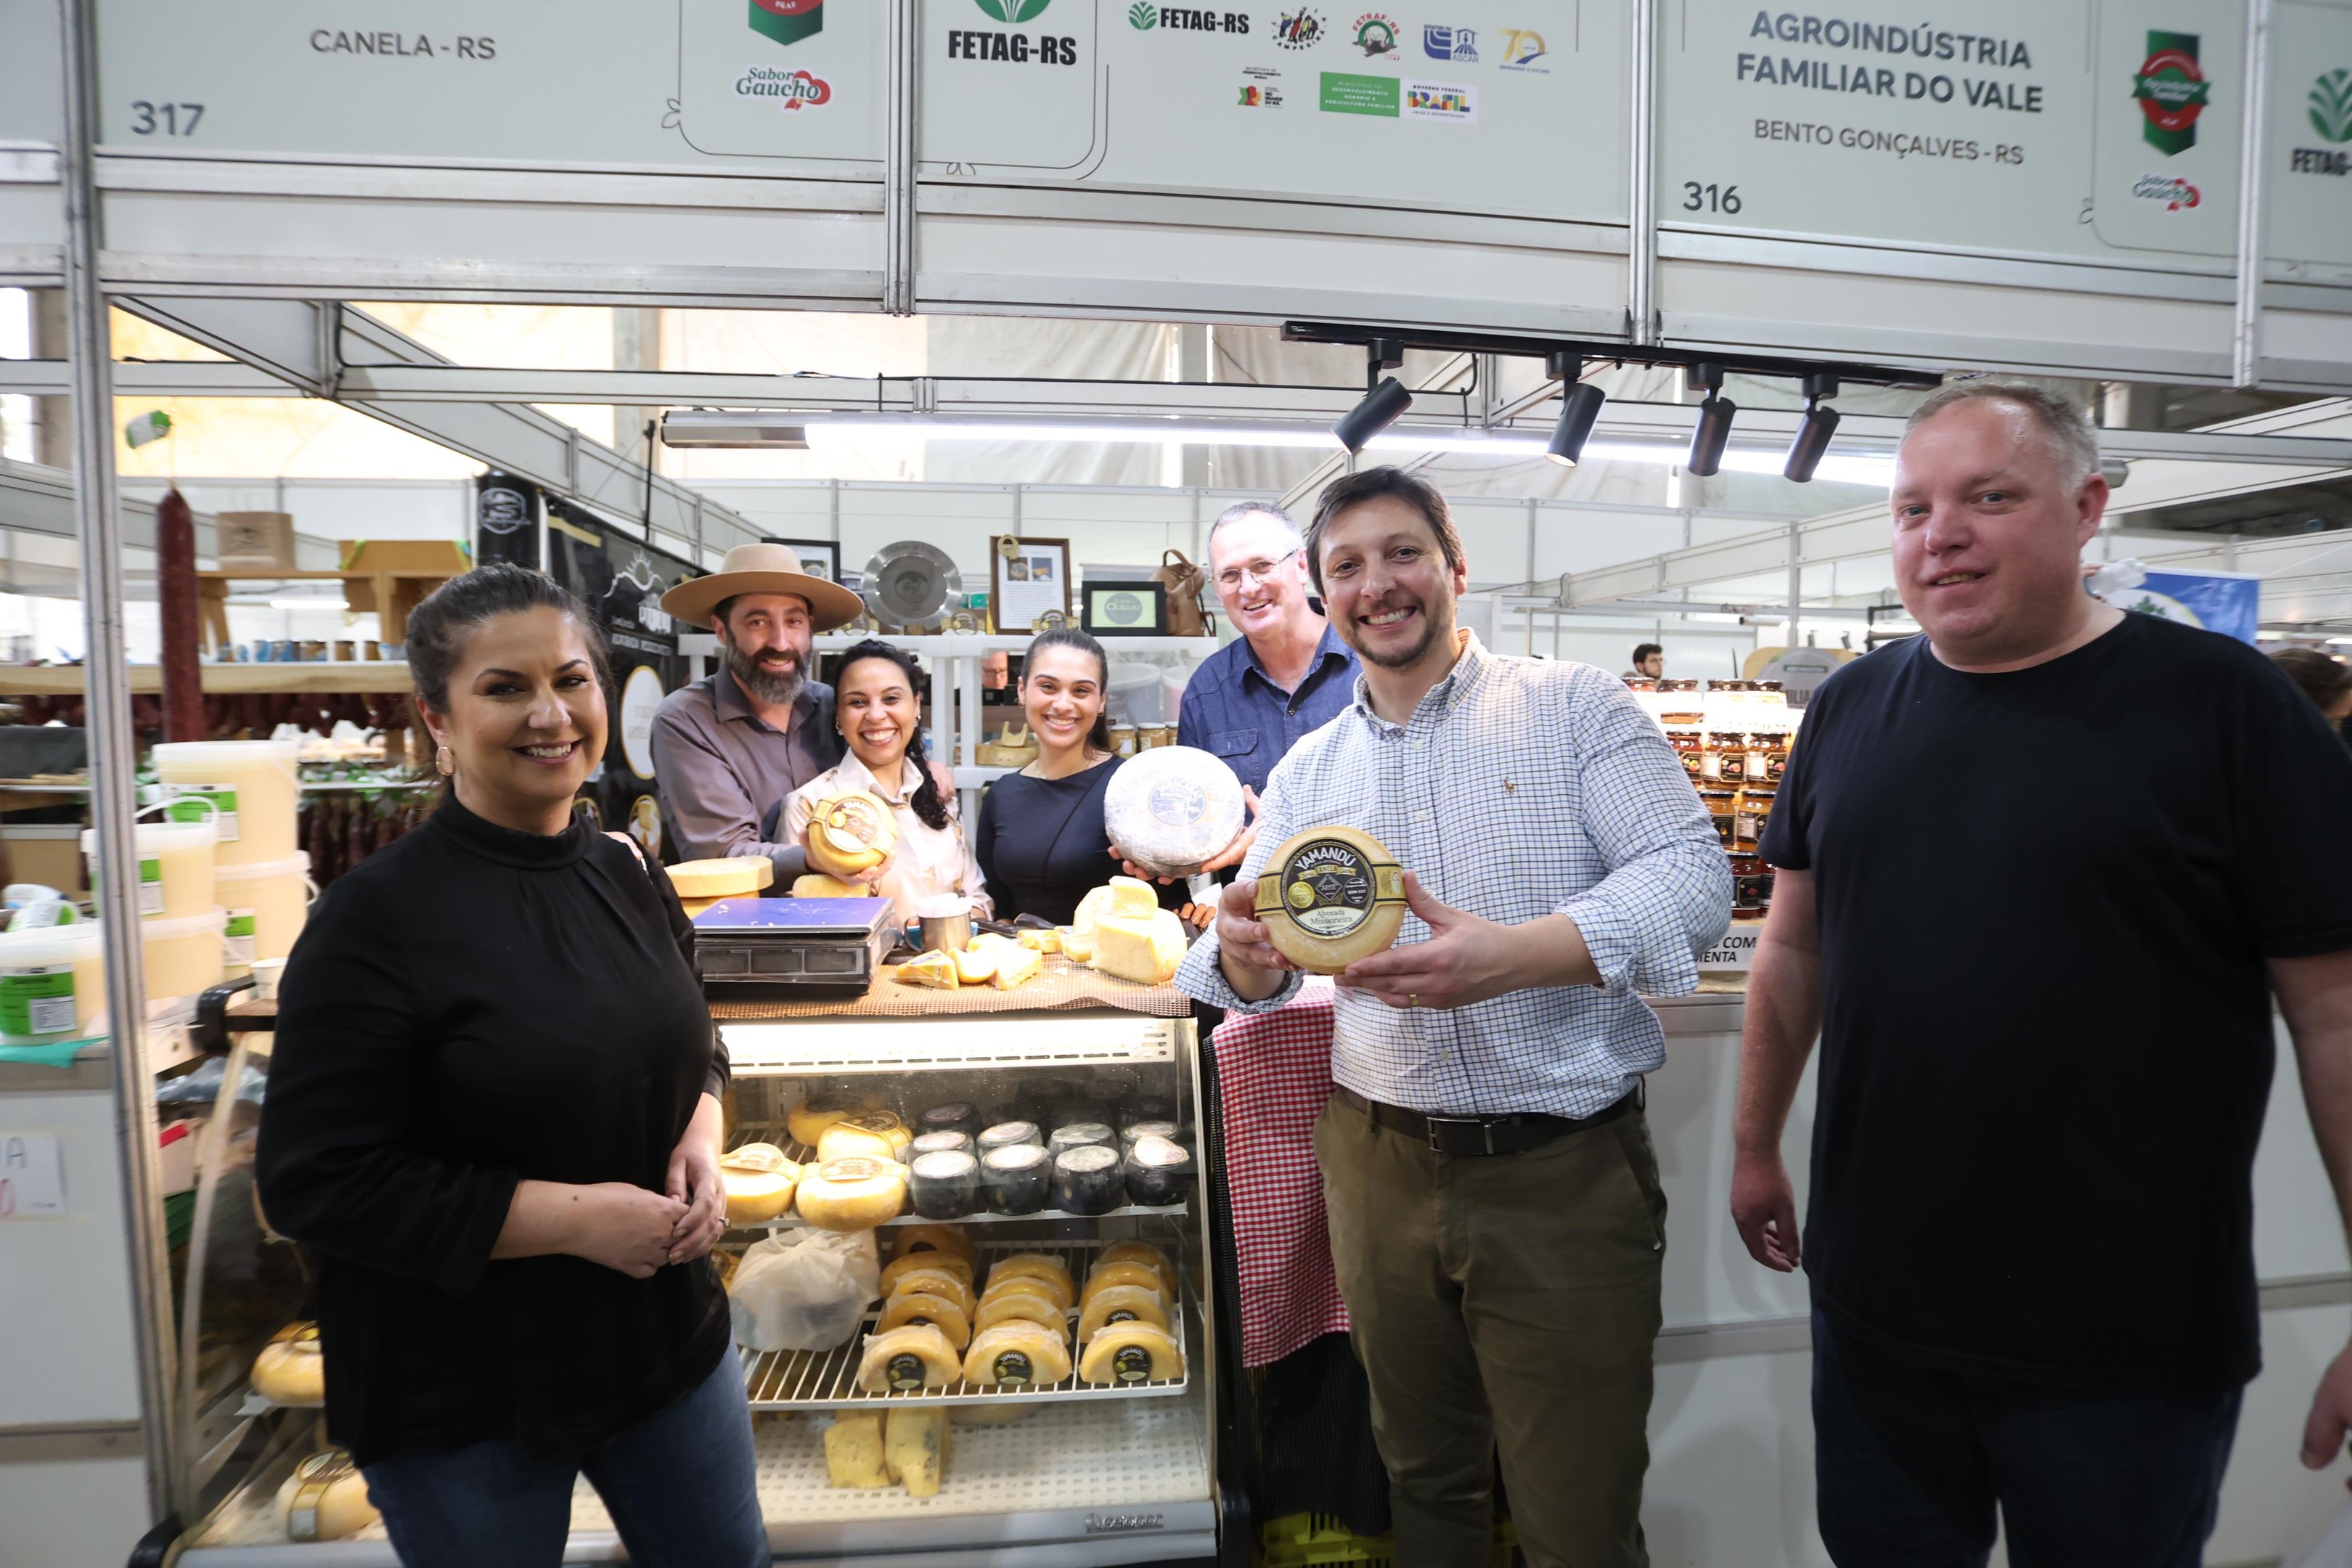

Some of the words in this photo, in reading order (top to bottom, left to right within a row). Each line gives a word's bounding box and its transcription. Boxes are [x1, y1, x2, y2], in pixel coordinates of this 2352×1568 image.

[1160, 7, 1250, 35] FETAG-RS
[310, 29, 435, 57] CANELA
[456, 36, 497, 60] RS
[948, 30, 1077, 65] FETAG-RS
[1750, 11, 2032, 69] AGROINDÚSTRIA
[748, 67, 794, 81] Sabor
[1736, 53, 1896, 97] FAMILIAR
[1905, 73, 1954, 103] DO
[1964, 78, 2043, 113] VALE
[1408, 91, 1471, 113] BRASIL
[131, 101, 205, 136] 317
[1755, 119, 1834, 145] BENTO
[1839, 128, 1979, 160] GONÇALVES
[1996, 144, 2024, 166] RS
[1683, 181, 1742, 214] 316
[1310, 917, 1353, 926] Missioneira
[1316, 908, 1345, 918] Alvorada
[1723, 936, 1757, 949] COM
